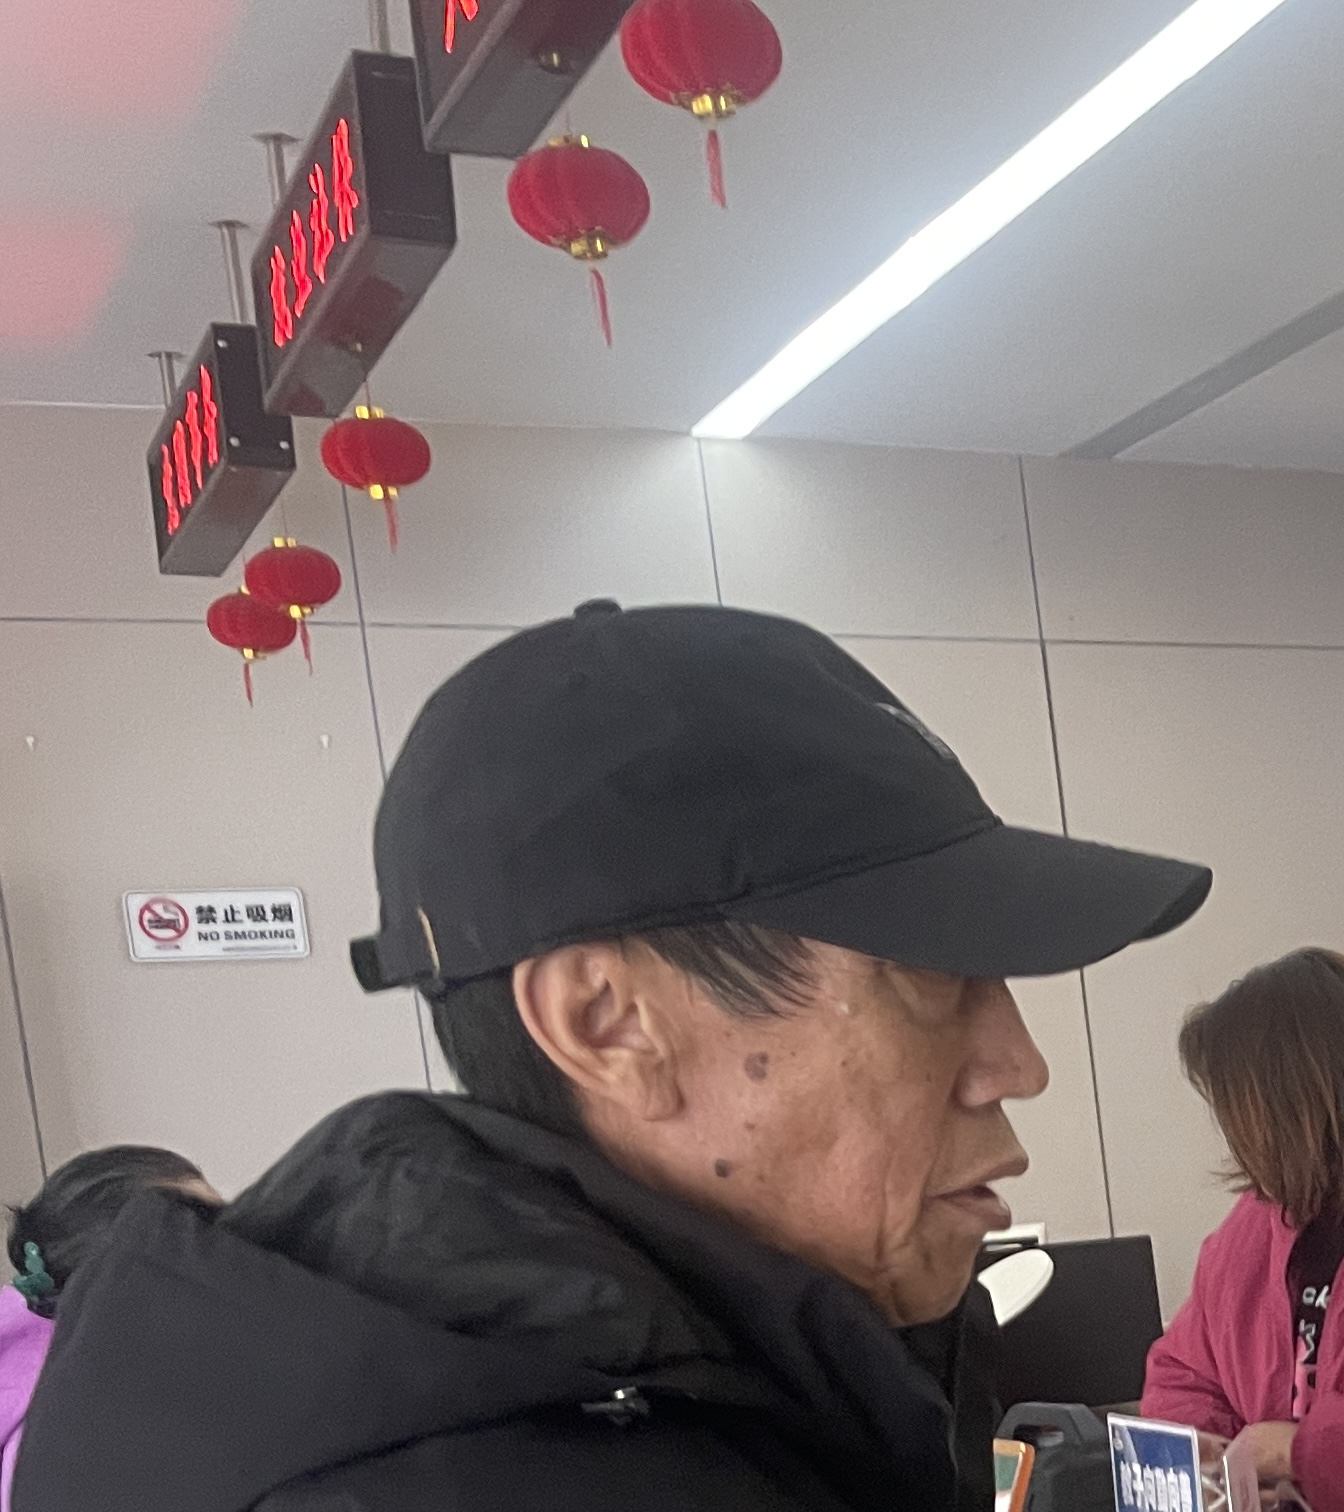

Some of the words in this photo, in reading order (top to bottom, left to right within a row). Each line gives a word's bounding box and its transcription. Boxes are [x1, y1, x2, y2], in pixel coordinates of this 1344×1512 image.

[195, 902, 293, 924] 禁止吸烟
[198, 930, 220, 942] NO
[224, 928, 296, 942] SMOKING
